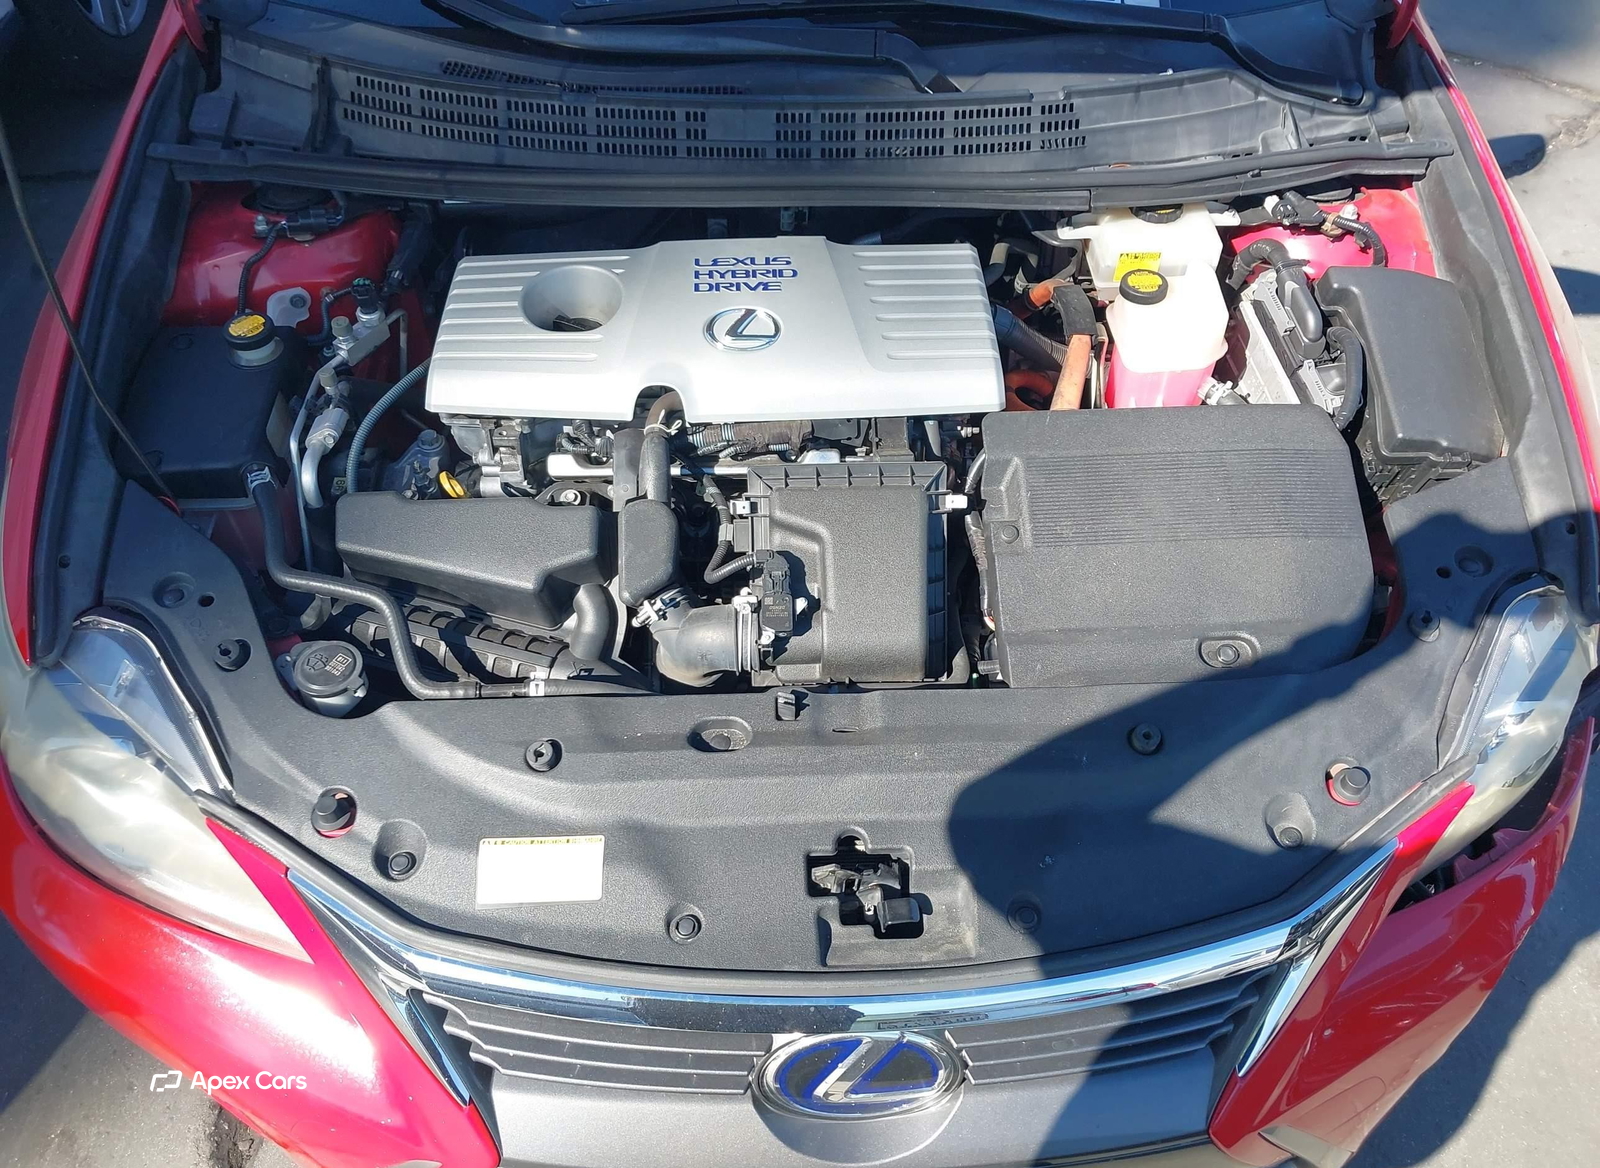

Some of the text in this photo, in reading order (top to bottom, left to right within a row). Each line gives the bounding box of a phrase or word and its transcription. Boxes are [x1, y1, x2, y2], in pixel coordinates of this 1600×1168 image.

[694, 256, 792, 267] LEXUS
[694, 268, 798, 280] HYBRID
[694, 281, 782, 292] DRIVE
